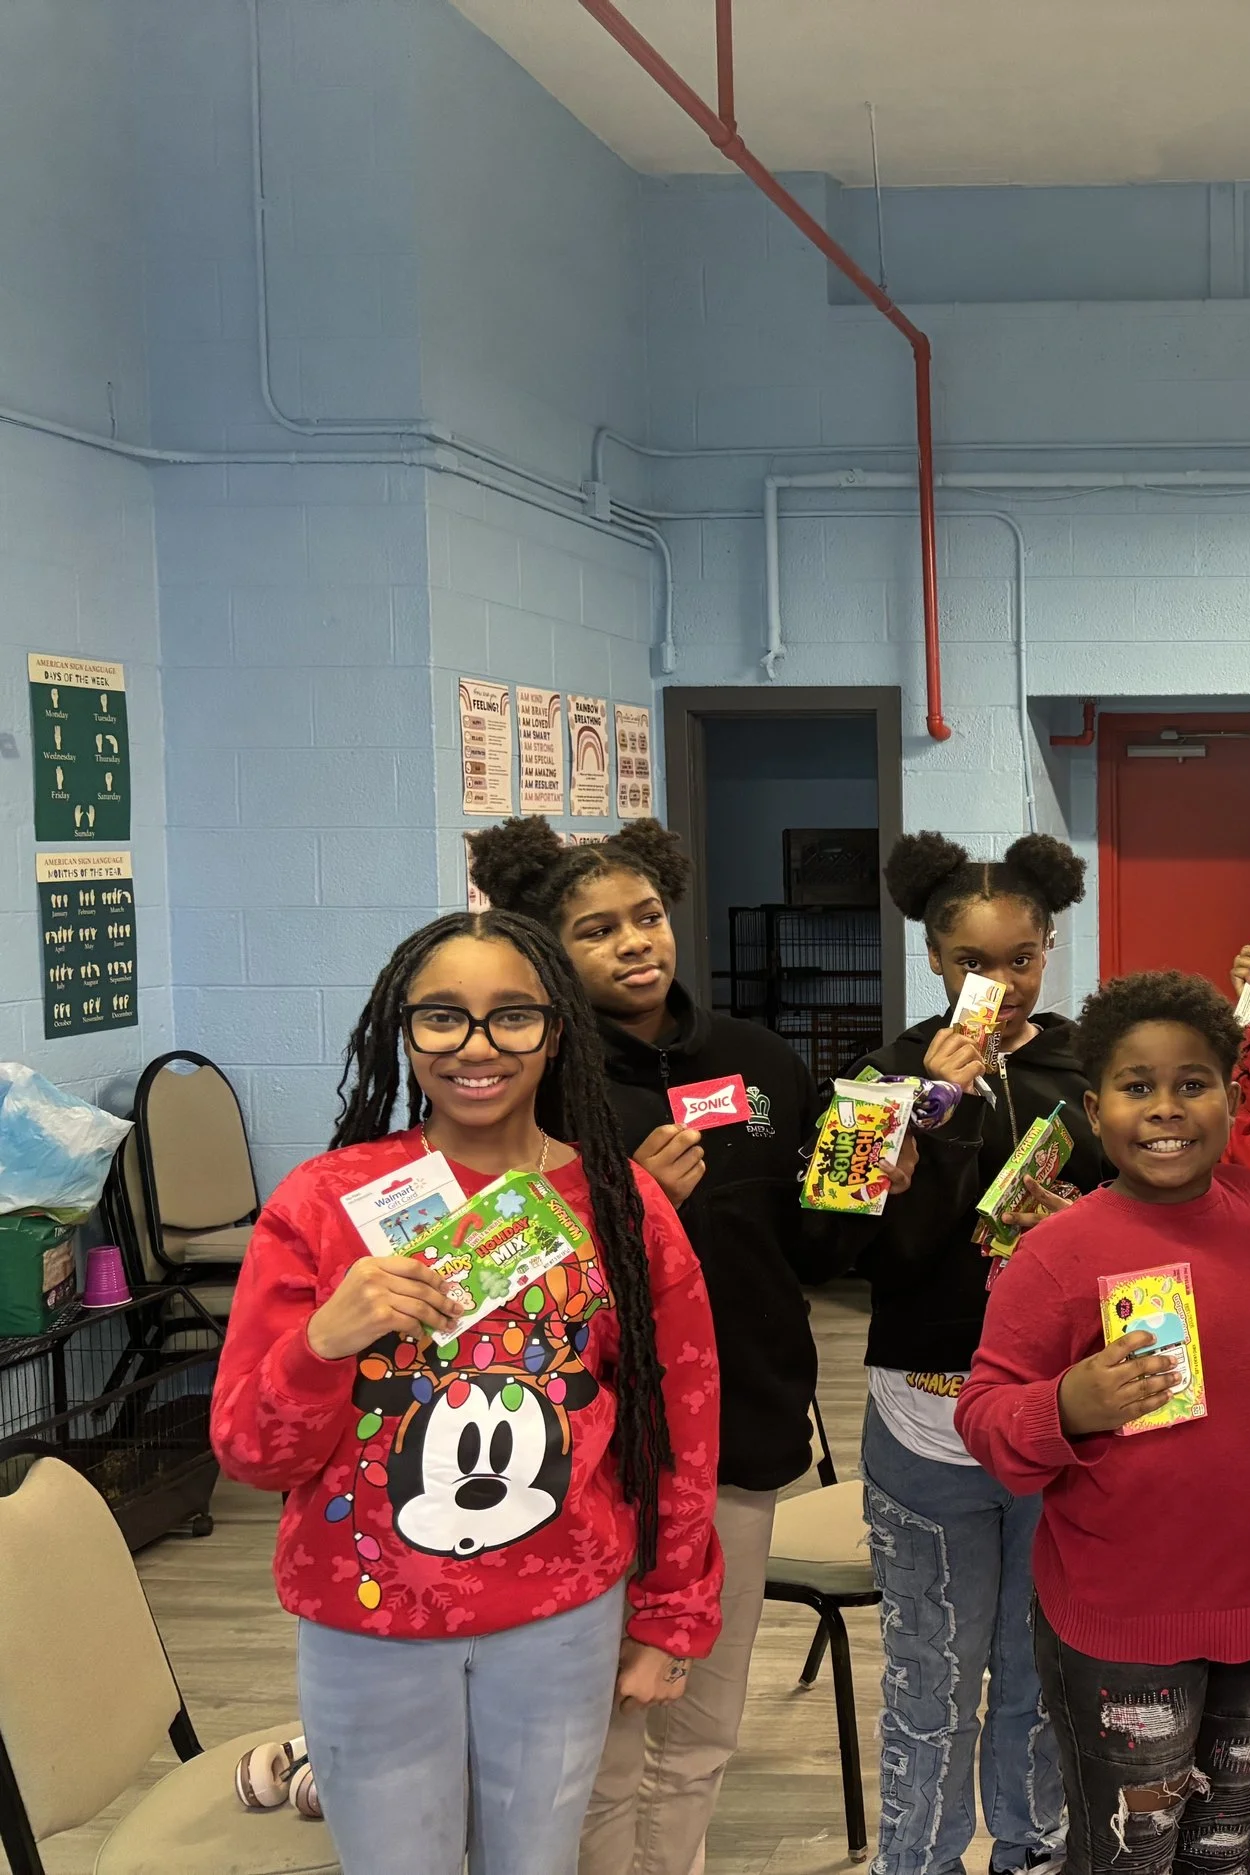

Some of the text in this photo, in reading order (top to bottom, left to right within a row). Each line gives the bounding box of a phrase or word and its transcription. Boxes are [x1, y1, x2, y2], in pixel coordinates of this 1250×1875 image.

[37, 659, 116, 674] AMERICAN SIGN LANGUAGE
[44, 670, 109, 686] DAYS OF THE WEEK
[520, 692, 530, 701] AM
[530, 693, 544, 703] KIND
[473, 699, 499, 713] FEELING?
[521, 705, 530, 714] AM
[531, 706, 548, 717] BRAVE
[576, 702, 598, 714] RAINBOW
[46, 709, 68, 720] Monday
[94, 713, 116, 724] Tuesday
[574, 714, 601, 726] BREATHING
[522, 718, 531, 727] AM
[532, 718, 549, 729] LOVED
[523, 730, 532, 739] AM
[532, 730, 550, 740] SMART
[524, 742, 532, 752] AM
[43, 752, 76, 762] Wednesday
[95, 754, 120, 764] Thursday
[525, 755, 533, 764] AM
[534, 755, 555, 765] SPECIAL
[525, 767, 534, 776] AM
[534, 768, 557, 778] AMAZING
[525, 780, 534, 788] AM
[534, 780, 559, 790] RESILIENT
[51, 790, 70, 801] Friday
[98, 792, 121, 802] Saturday
[525, 792, 534, 801] AM
[74, 830, 96, 839] Sunday
[44, 856, 124, 866] AMERICAN SIGN LANGUAGE
[48, 867, 122, 879] MONTHS OF THE YEAR
[84, 942, 94, 950] May
[82, 978, 98, 987] August
[82, 1014, 104, 1023] November
[110, 1010, 133, 1019] December
[53, 1020, 72, 1028] October
[689, 1096, 730, 1114] SONIC
[829, 1130, 857, 1183] SOUR
[848, 1130, 877, 1185] PATCH
[374, 1184, 416, 1208] Walmart
[388, 1192, 418, 1210] Gift Card
[474, 1216, 530, 1259] HOLIDAY
[490, 1233, 530, 1266] MIX
[916, 1371, 965, 1398] HAVE
